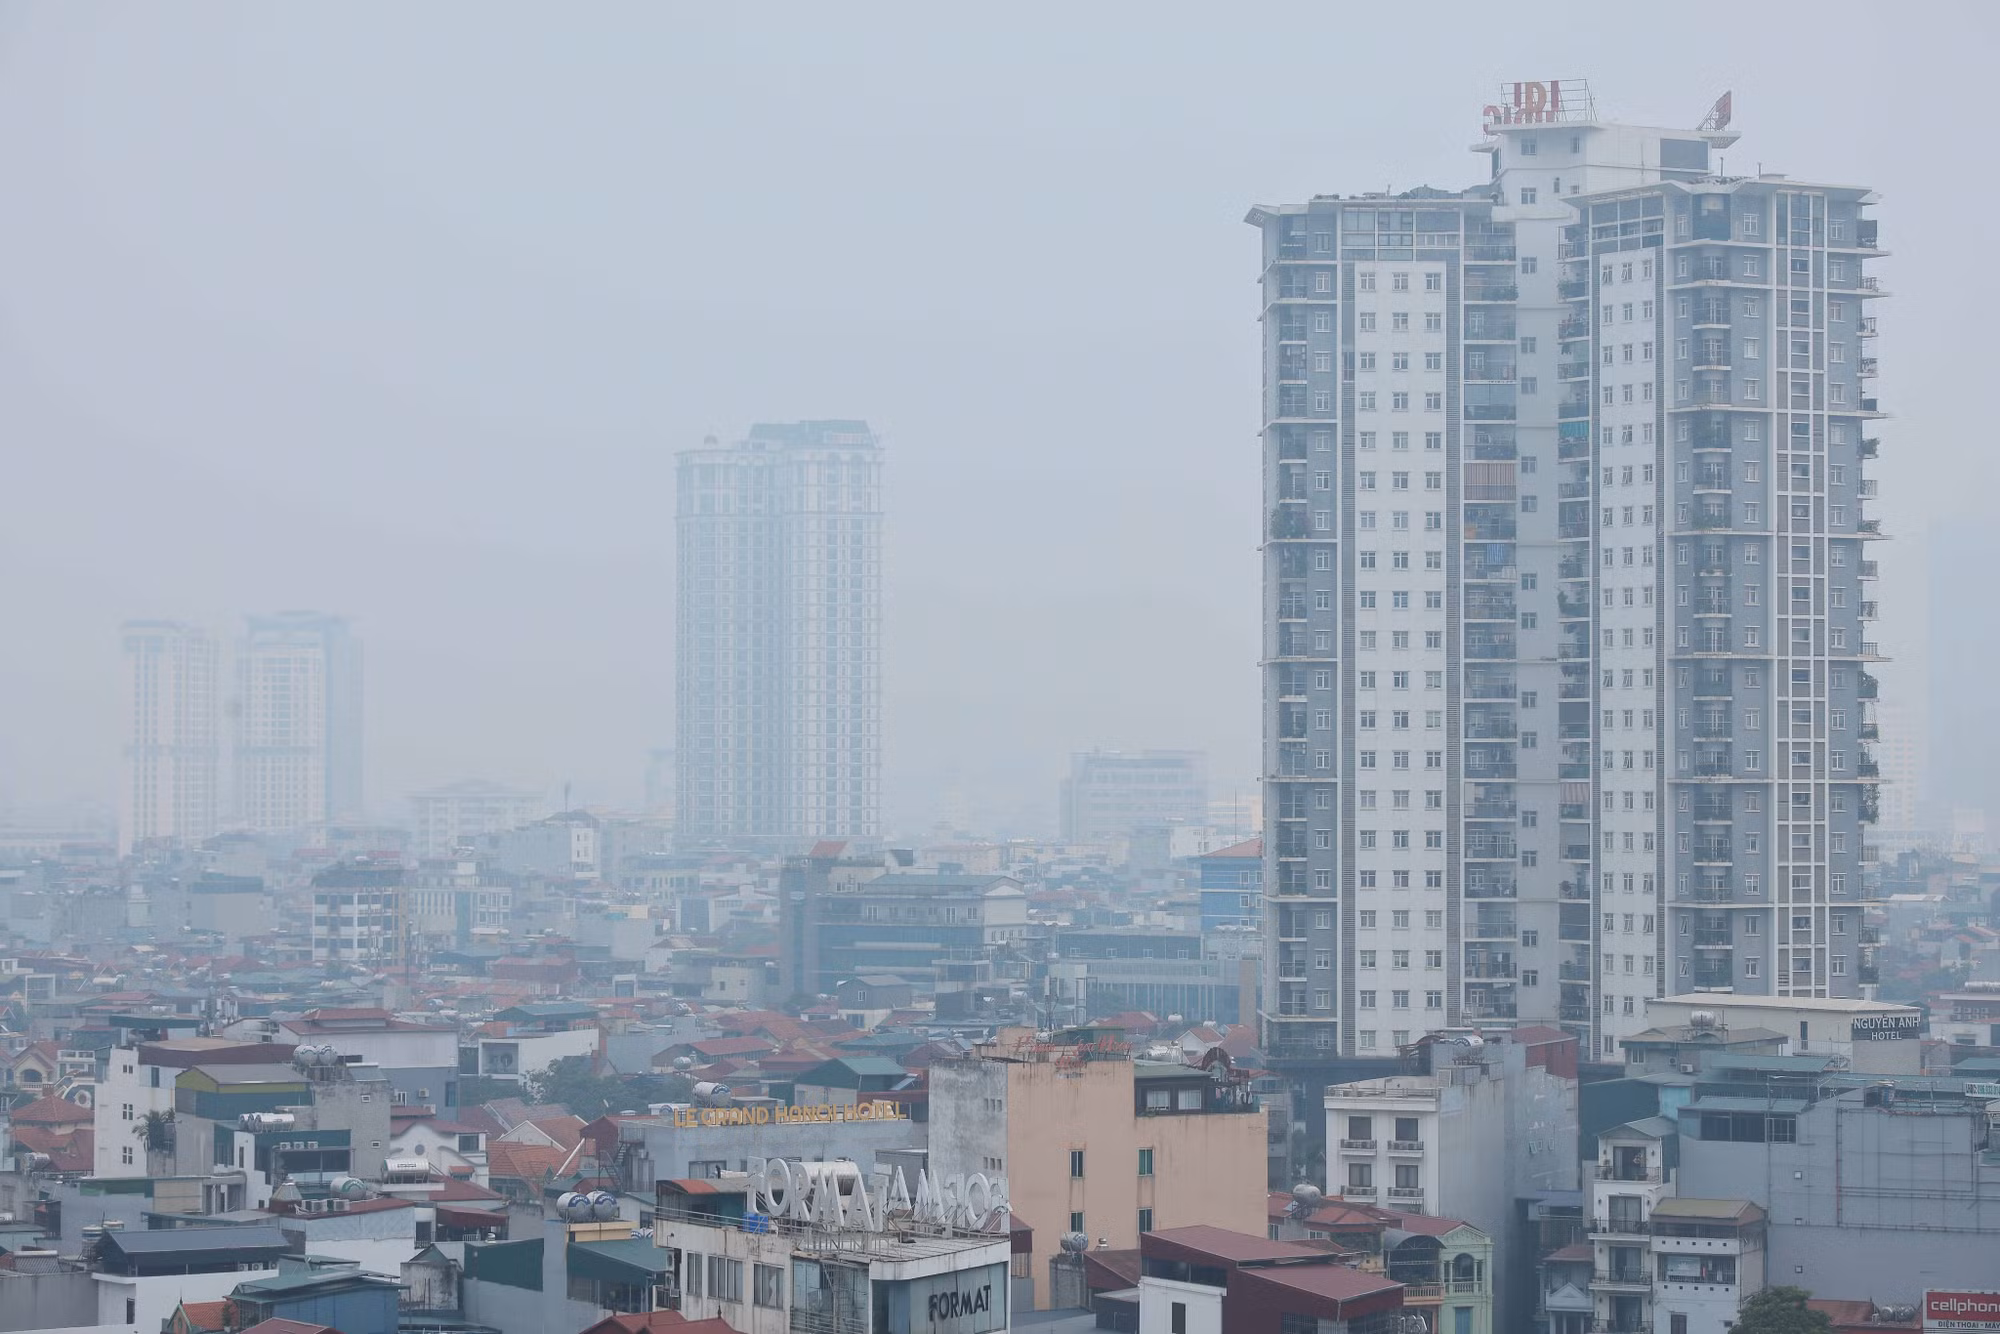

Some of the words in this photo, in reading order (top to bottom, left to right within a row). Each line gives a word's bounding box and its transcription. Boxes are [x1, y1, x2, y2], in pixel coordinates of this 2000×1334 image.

[1898, 1017, 1919, 1028] ANH
[1871, 1031, 1902, 1040] HOTEL
[674, 1108, 698, 1127] LE
[701, 1107, 769, 1126] GRAND
[775, 1104, 836, 1124] HANOI
[844, 1101, 907, 1121] HOTEL
[746, 1156, 889, 1232] FORMAT
[928, 1284, 991, 1322] FORMAT
[1931, 1298, 2000, 1315] cellphon
